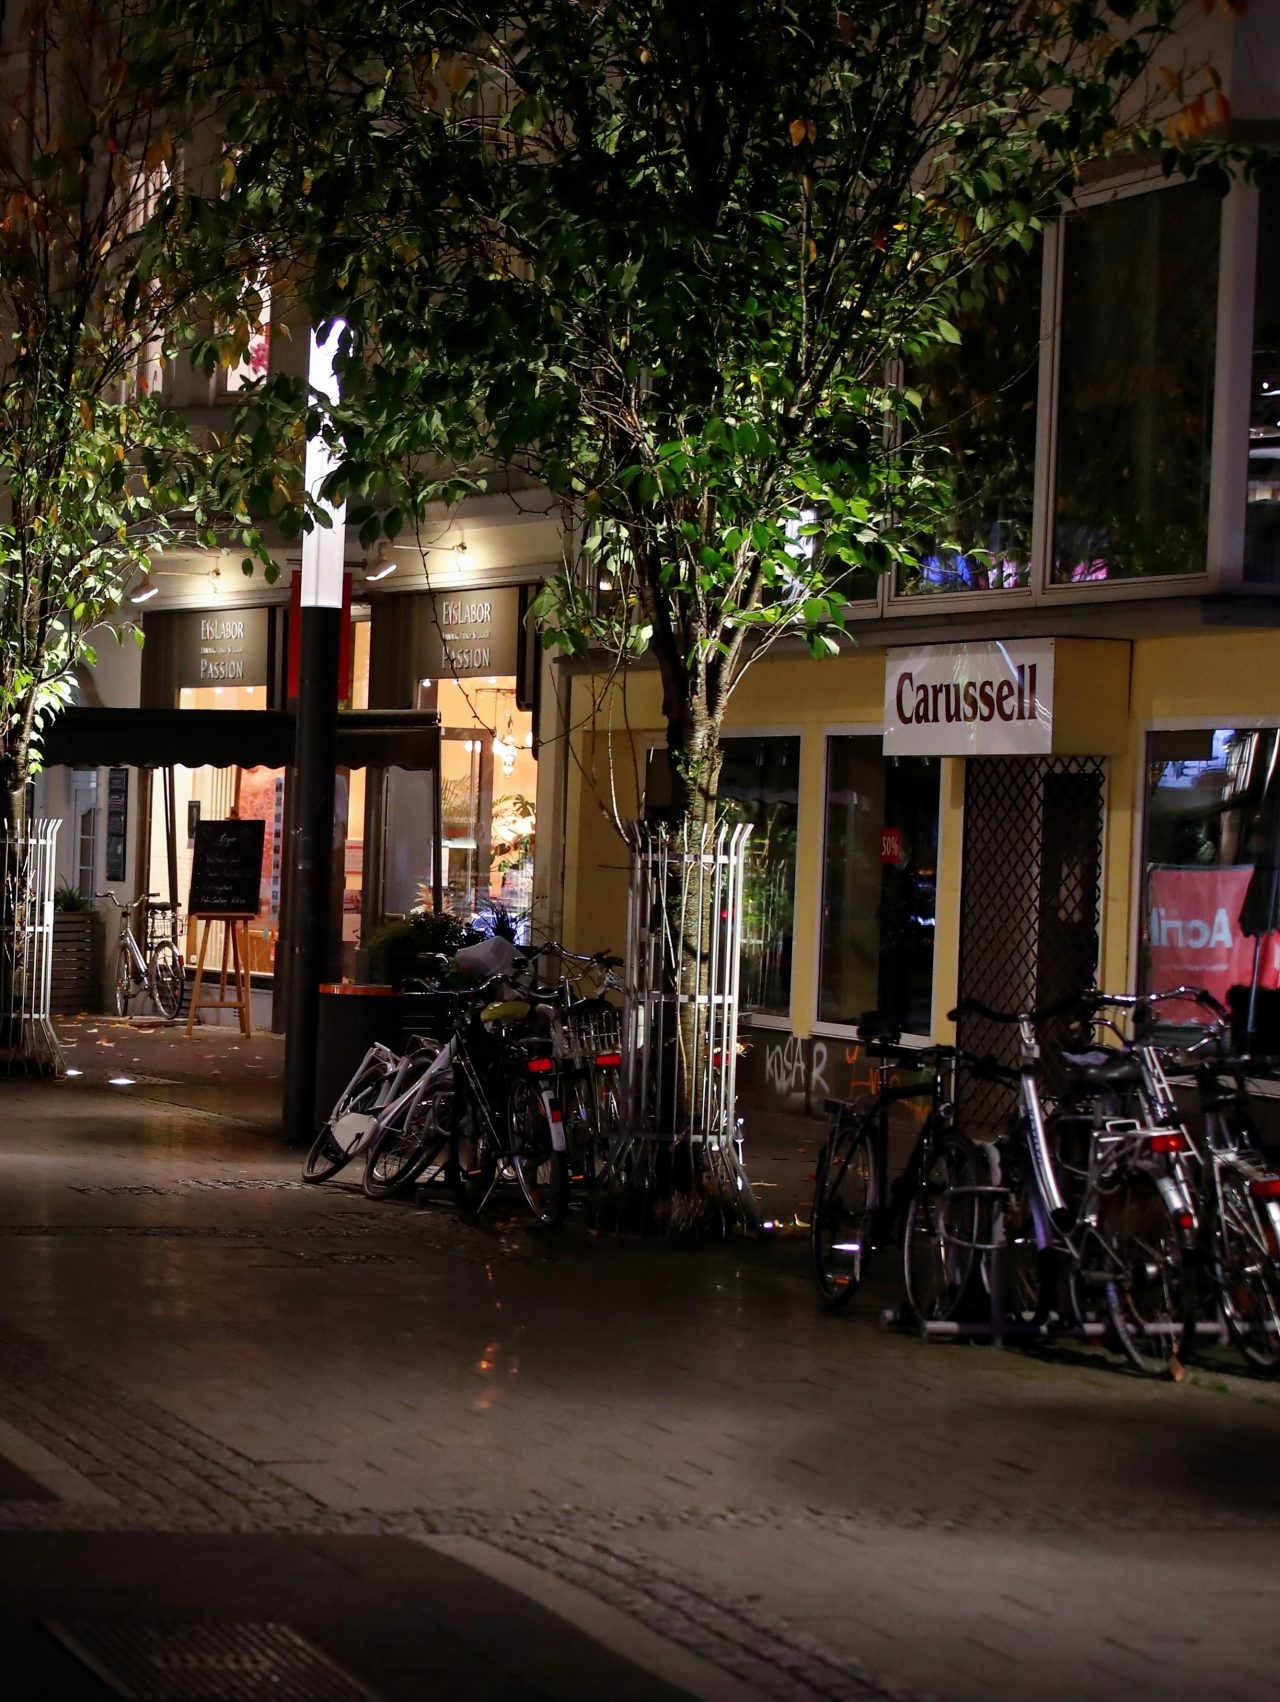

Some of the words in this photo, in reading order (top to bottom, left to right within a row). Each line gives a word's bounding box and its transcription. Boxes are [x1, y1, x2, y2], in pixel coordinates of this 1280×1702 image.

[200, 658, 244, 680] PASSION
[441, 645, 490, 670] PASSION
[896, 664, 1037, 725] Carussell
[881, 835, 900, 857] 50%
